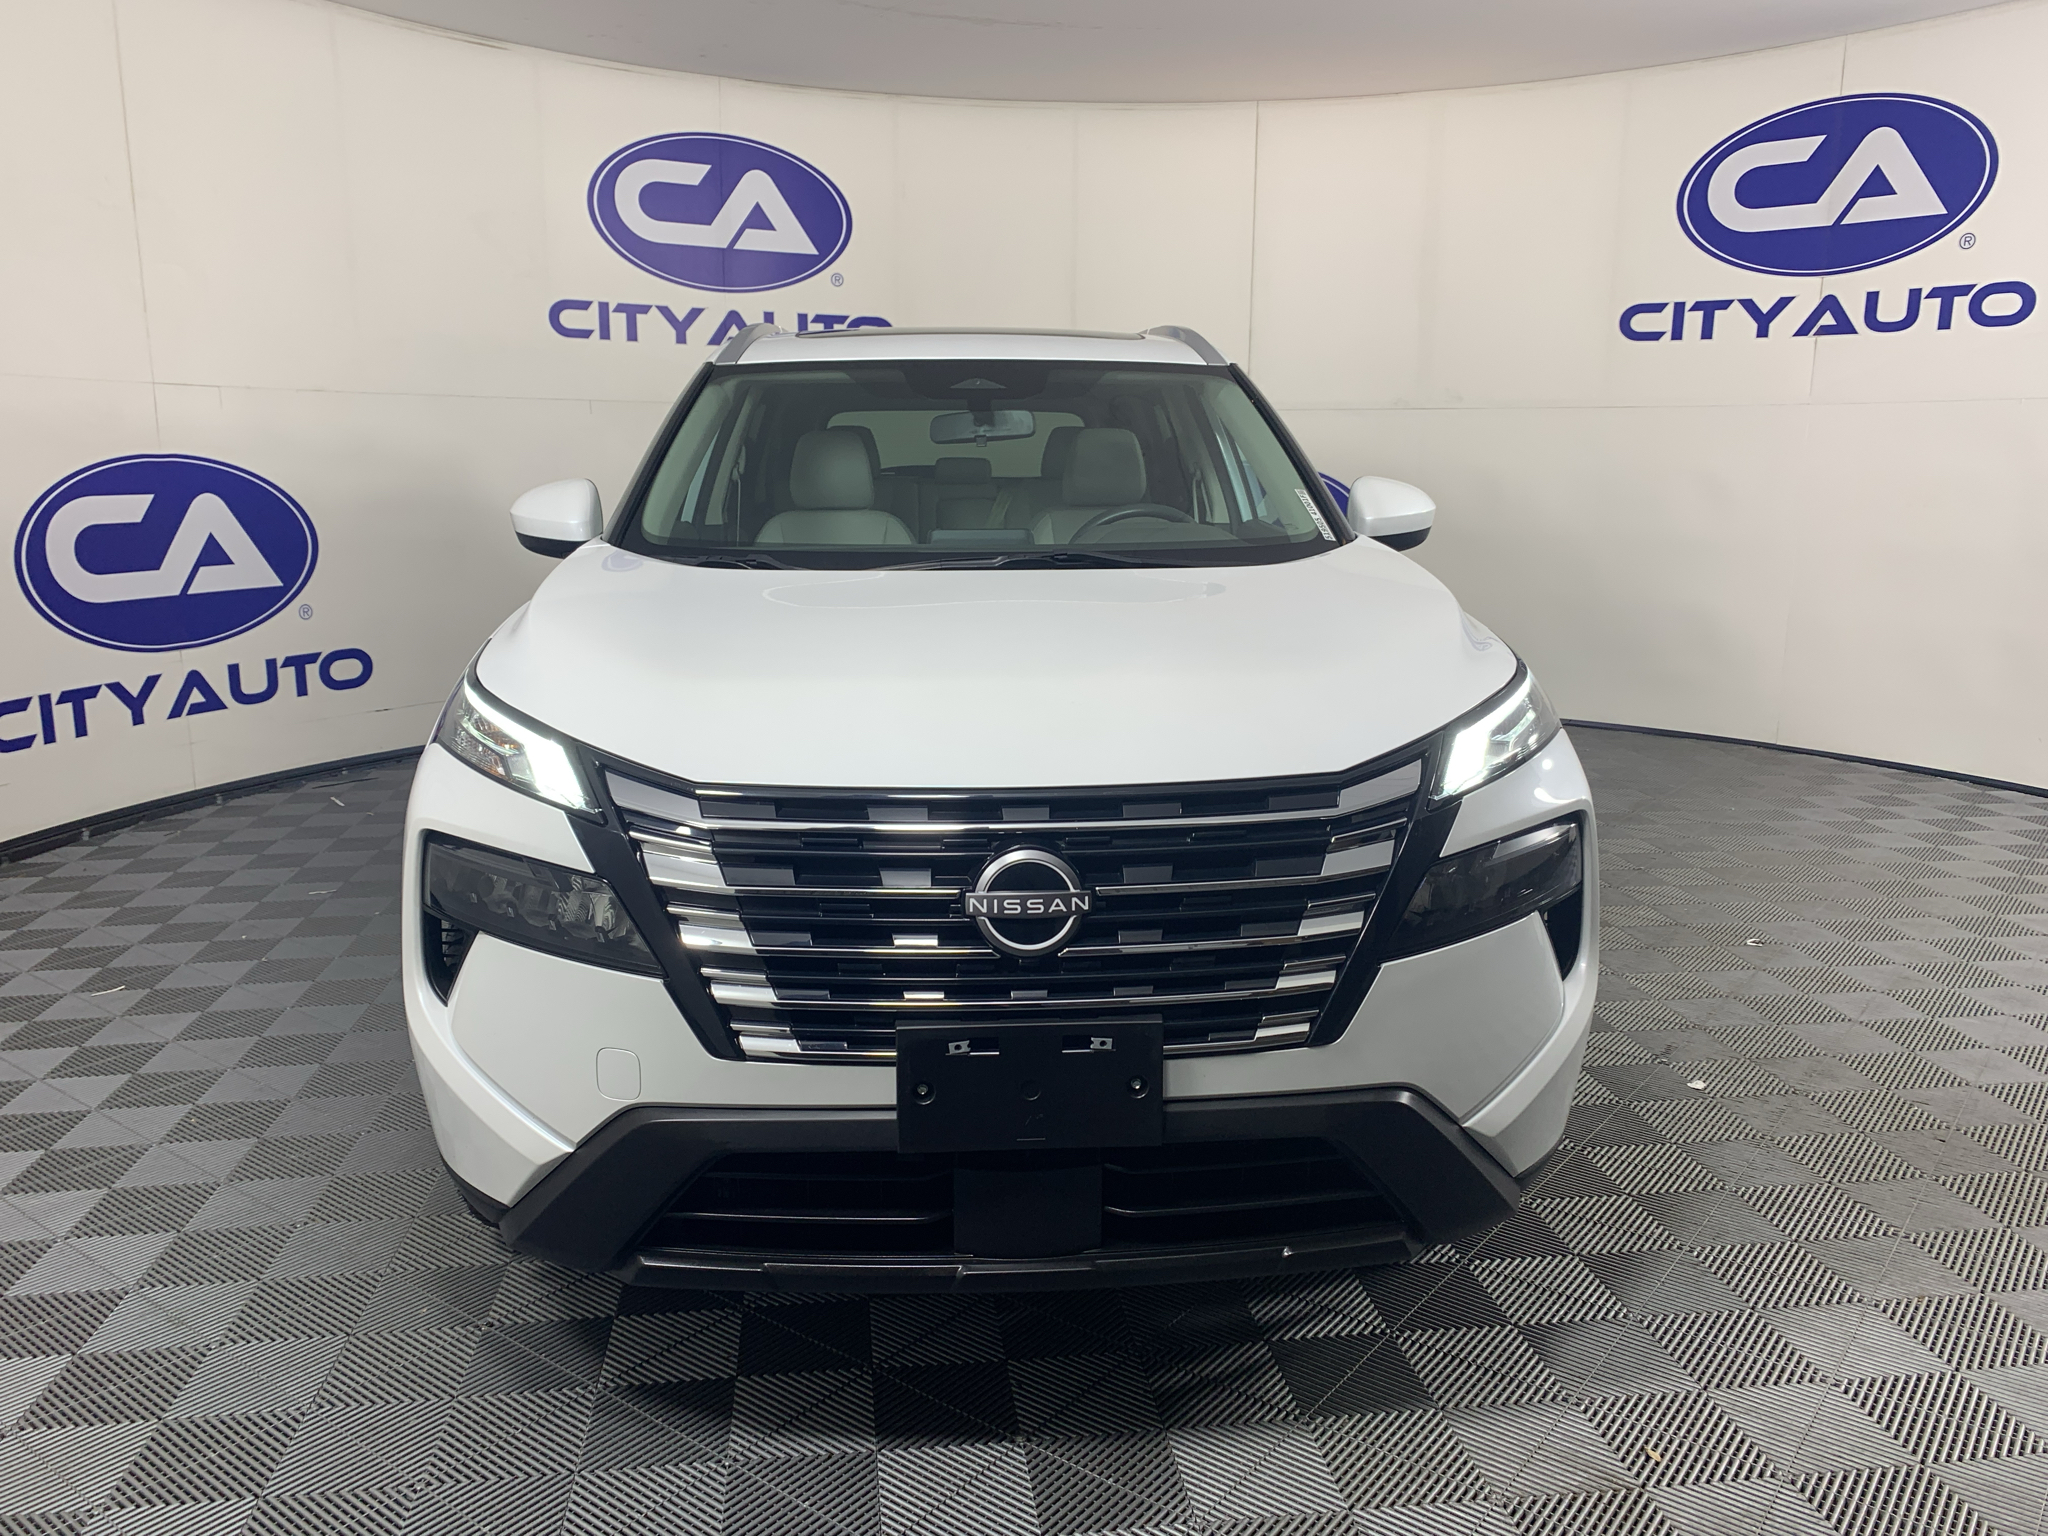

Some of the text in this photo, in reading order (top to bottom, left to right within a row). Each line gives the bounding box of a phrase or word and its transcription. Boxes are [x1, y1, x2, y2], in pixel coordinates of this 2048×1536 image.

[614, 158, 819, 255] CA
[1707, 126, 1948, 233] CA
[45, 492, 284, 603] CA
[969, 895, 1089, 914] NISSAN
